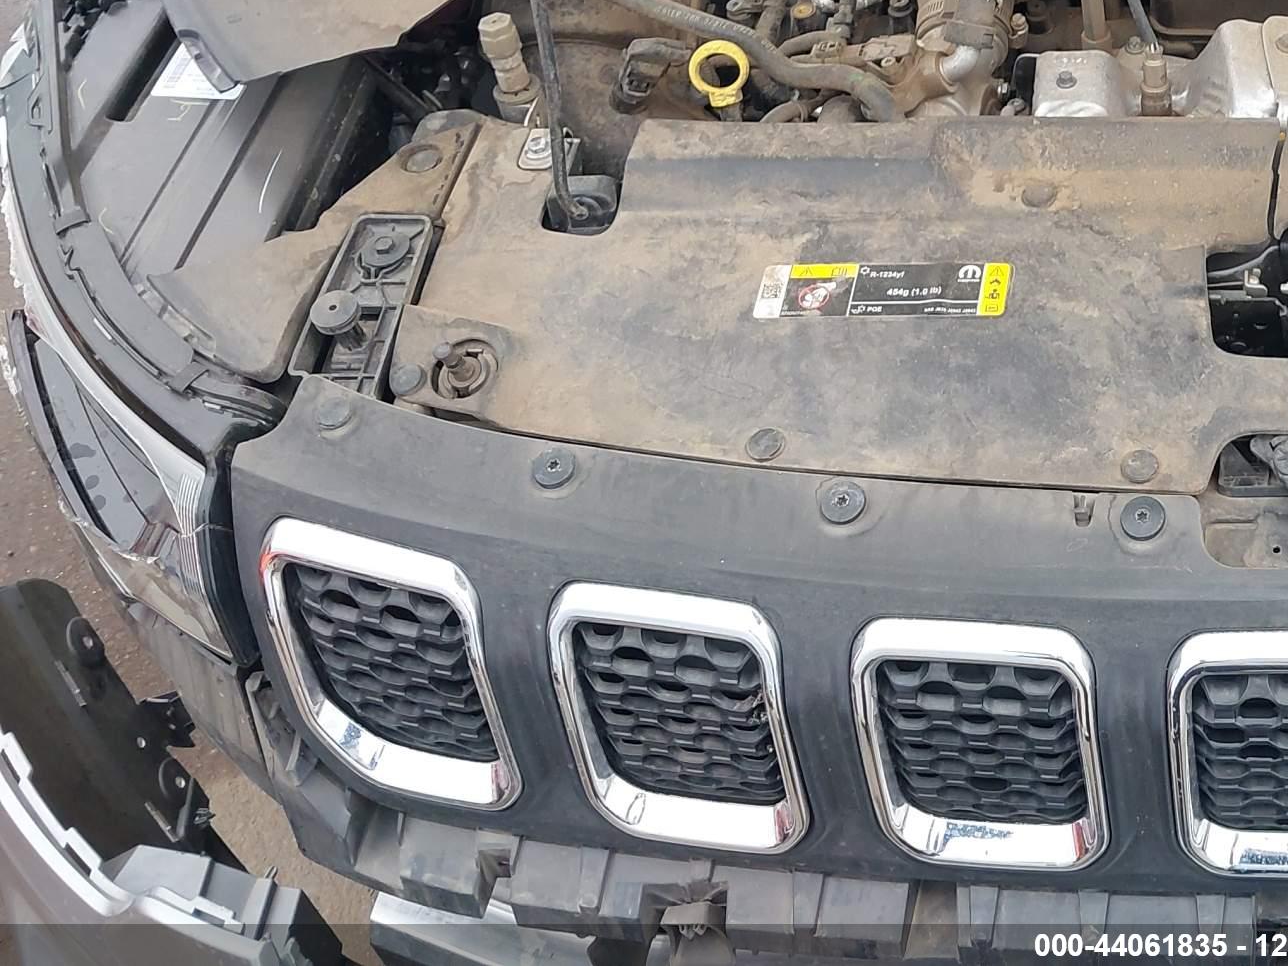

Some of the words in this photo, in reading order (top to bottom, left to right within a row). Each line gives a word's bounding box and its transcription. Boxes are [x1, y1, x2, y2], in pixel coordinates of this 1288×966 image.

[869, 270, 905, 279] R-1234yf
[886, 287, 910, 297] 454g
[911, 287, 929, 297] (1.0
[929, 285, 942, 296] lb)
